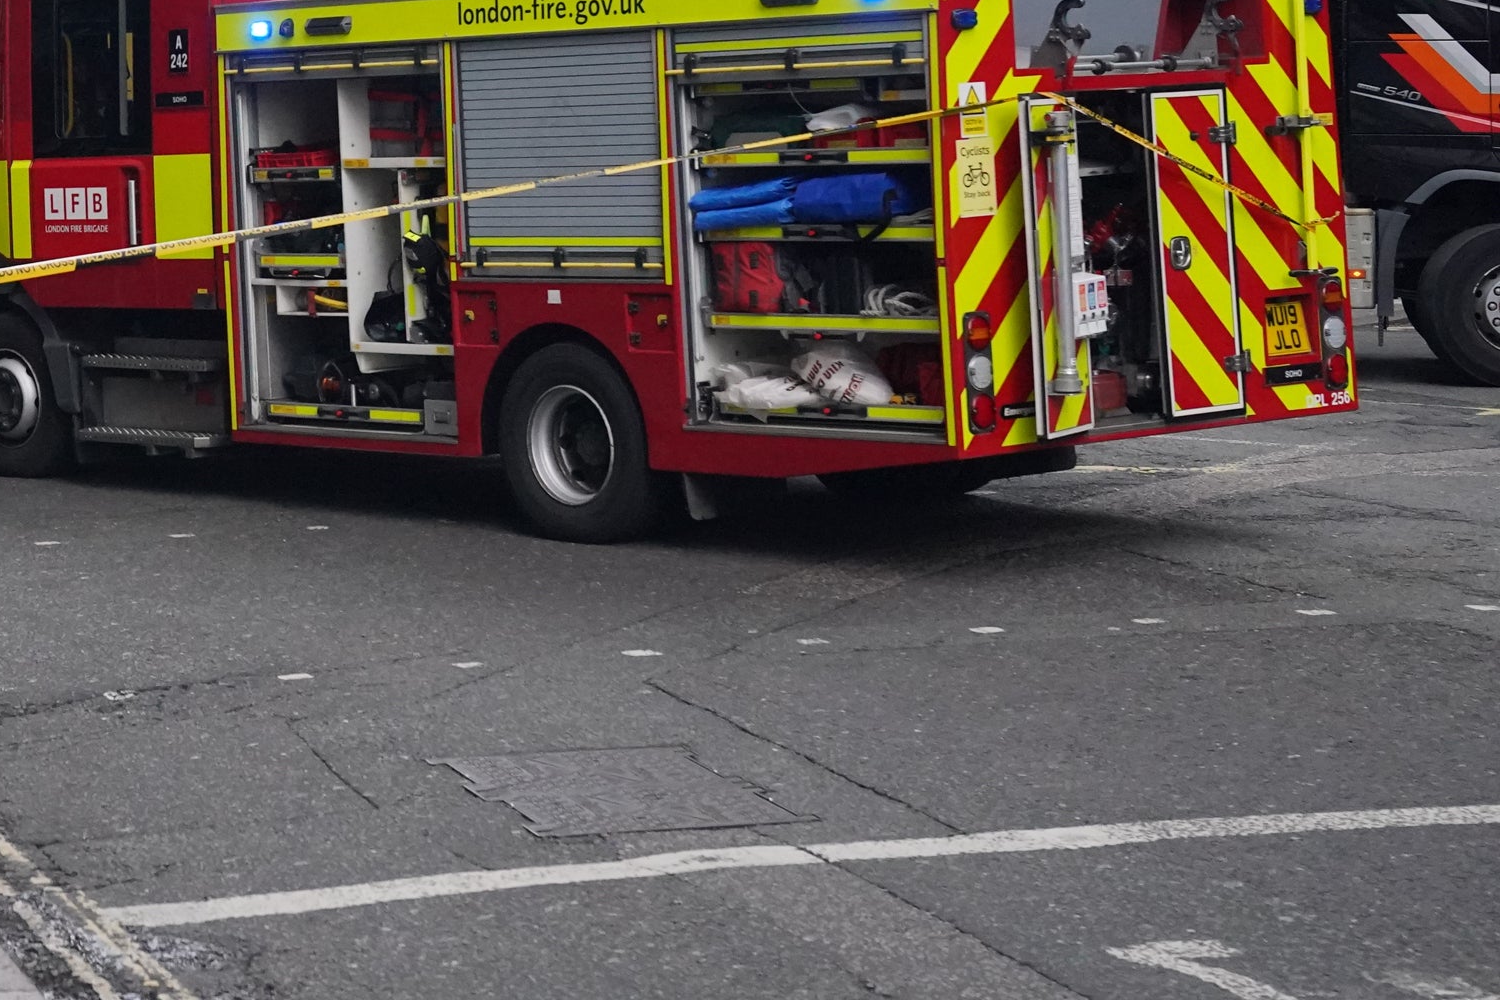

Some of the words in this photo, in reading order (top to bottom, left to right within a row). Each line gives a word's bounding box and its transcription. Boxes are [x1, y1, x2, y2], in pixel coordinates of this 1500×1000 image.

[175, 34, 183, 50] A
[170, 53, 188, 69] 242
[1383, 85, 1421, 101] 540
[960, 146, 991, 159] Cyclists
[963, 190, 977, 200] Stay
[45, 224, 69, 233] LONDON
[70, 224, 82, 233] FIRE
[84, 224, 108, 233] BRIGADE
[1265, 304, 1298, 327] WU19
[1274, 329, 1302, 350] JLO
[1284, 369, 1303, 378] SOHO
[1331, 391, 1351, 406] 256
